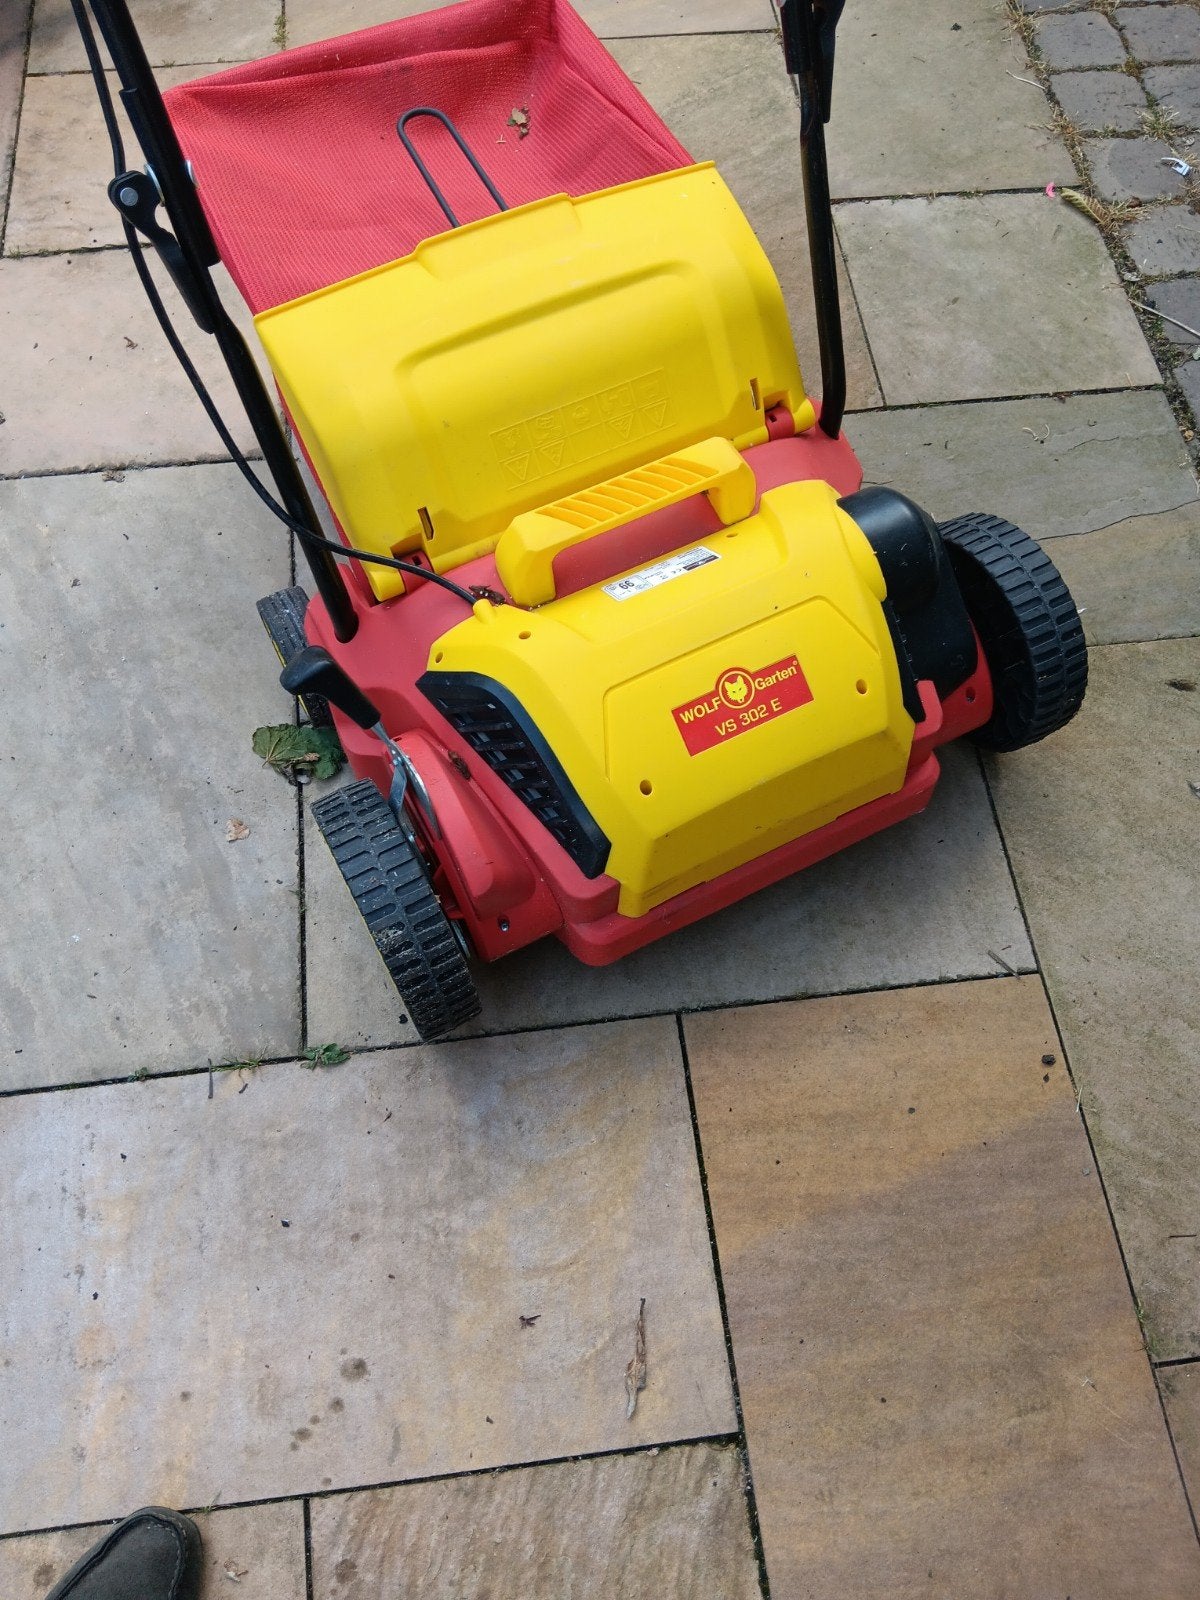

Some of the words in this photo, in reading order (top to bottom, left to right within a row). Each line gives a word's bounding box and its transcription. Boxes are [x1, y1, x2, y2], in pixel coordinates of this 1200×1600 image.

[680, 696, 721, 724] WOLF
[715, 718, 737, 736] VS
[739, 704, 769, 726] 302
[771, 698, 783, 712] E
